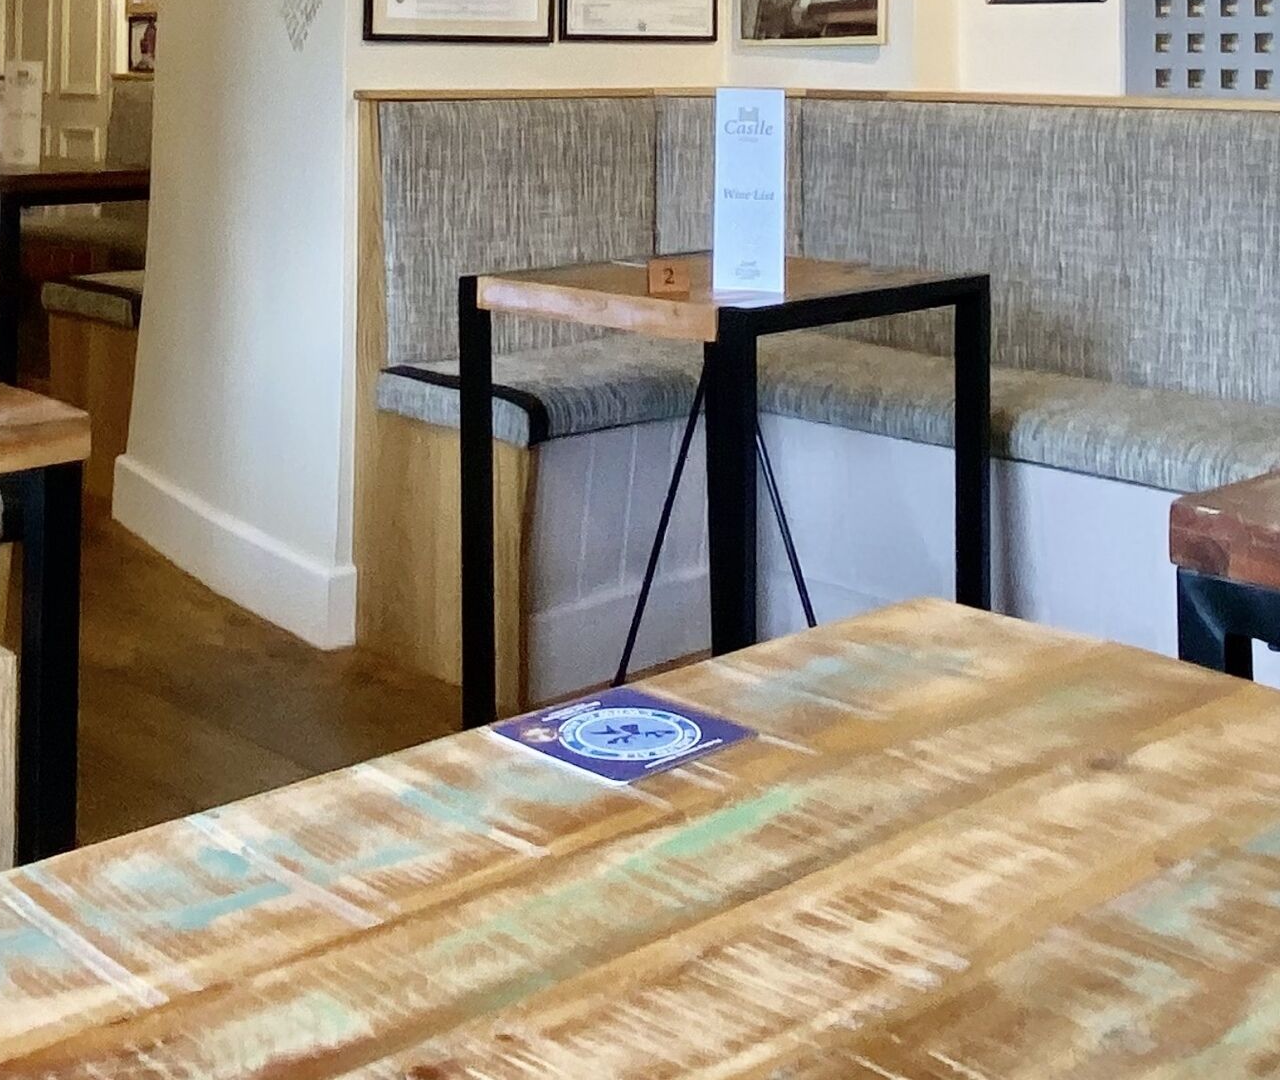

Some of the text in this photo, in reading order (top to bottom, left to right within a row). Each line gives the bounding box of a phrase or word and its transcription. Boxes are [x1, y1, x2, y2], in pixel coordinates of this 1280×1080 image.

[724, 119, 774, 137] Castle
[723, 188, 775, 201] Wine List
[663, 267, 675, 284] 2
